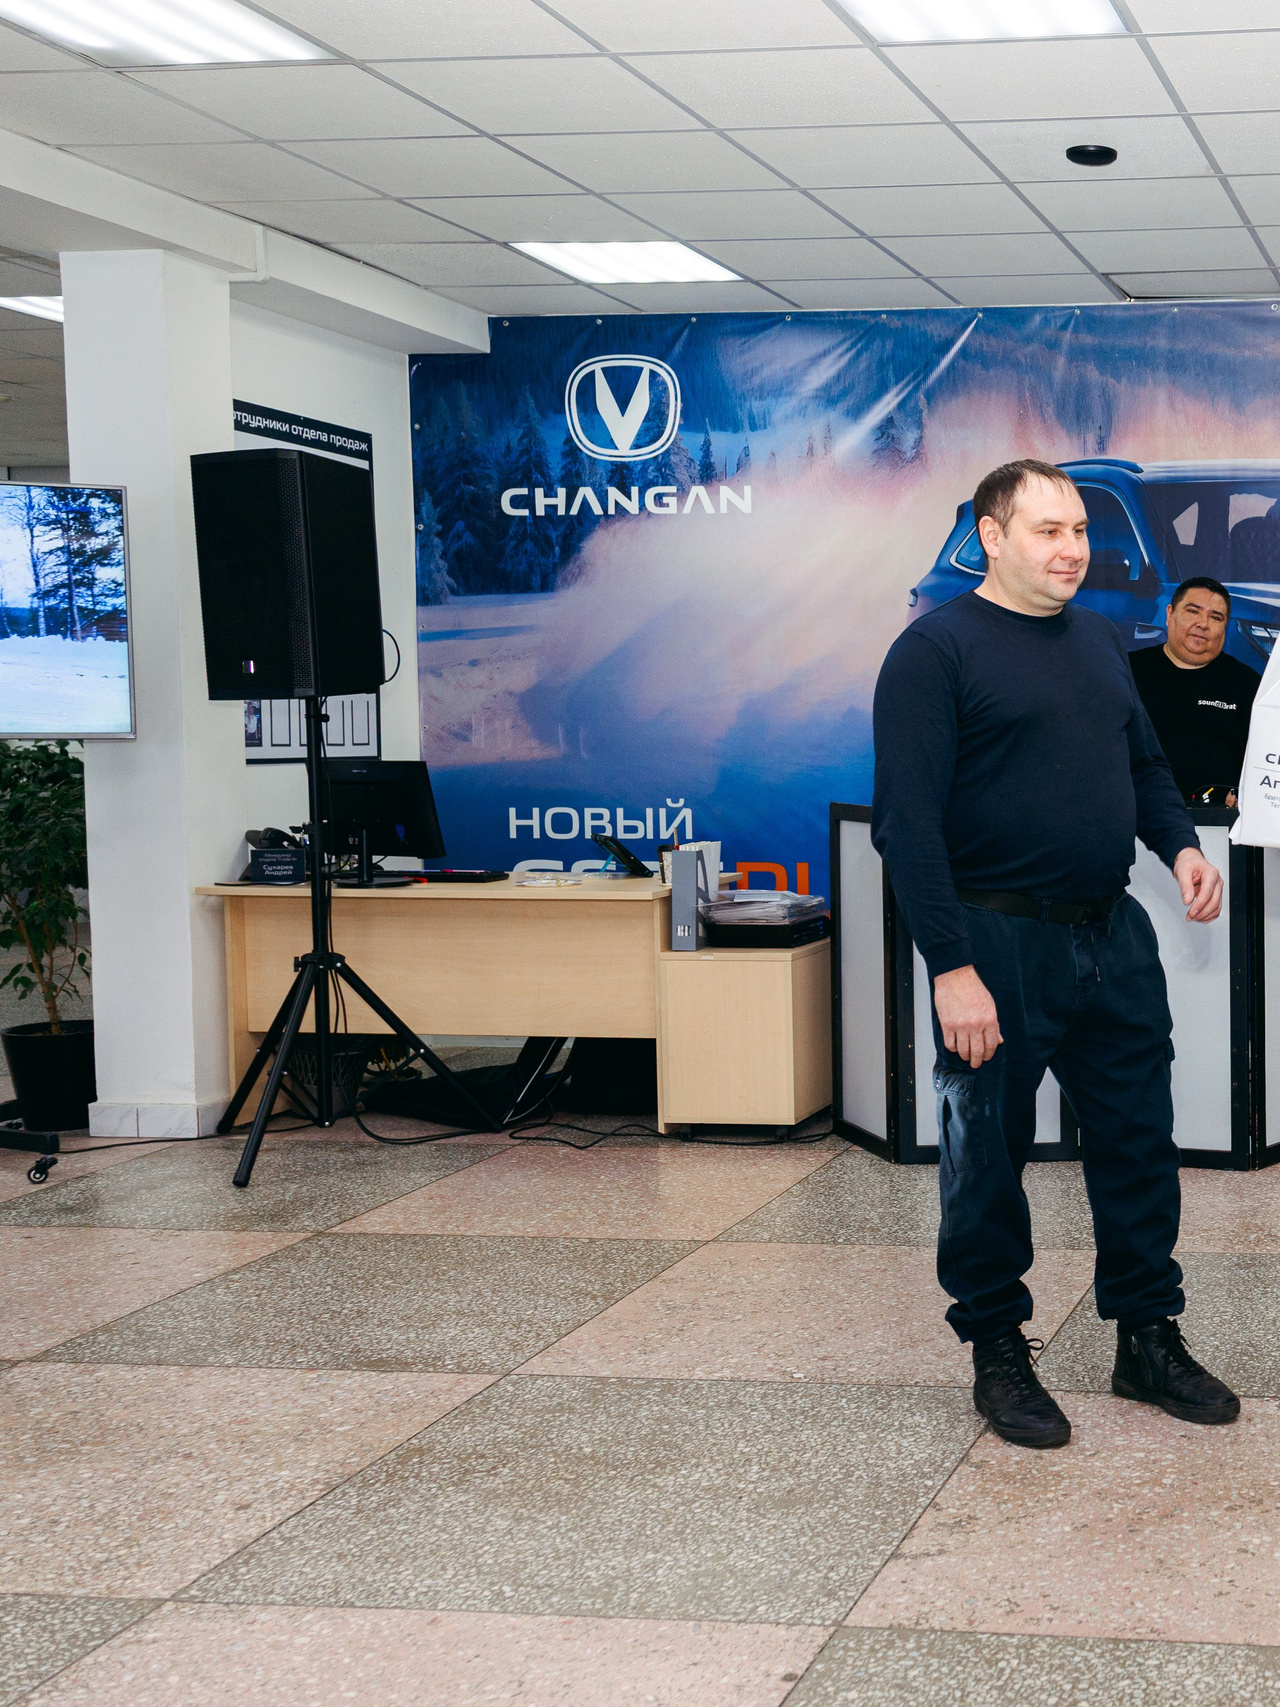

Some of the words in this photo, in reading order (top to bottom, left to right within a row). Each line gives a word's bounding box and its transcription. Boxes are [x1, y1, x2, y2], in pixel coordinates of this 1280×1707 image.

[291, 424, 328, 441] отдела
[329, 434, 369, 452] продаж
[501, 485, 752, 516] CHANGAN
[508, 798, 693, 840] НОВЫЙ
